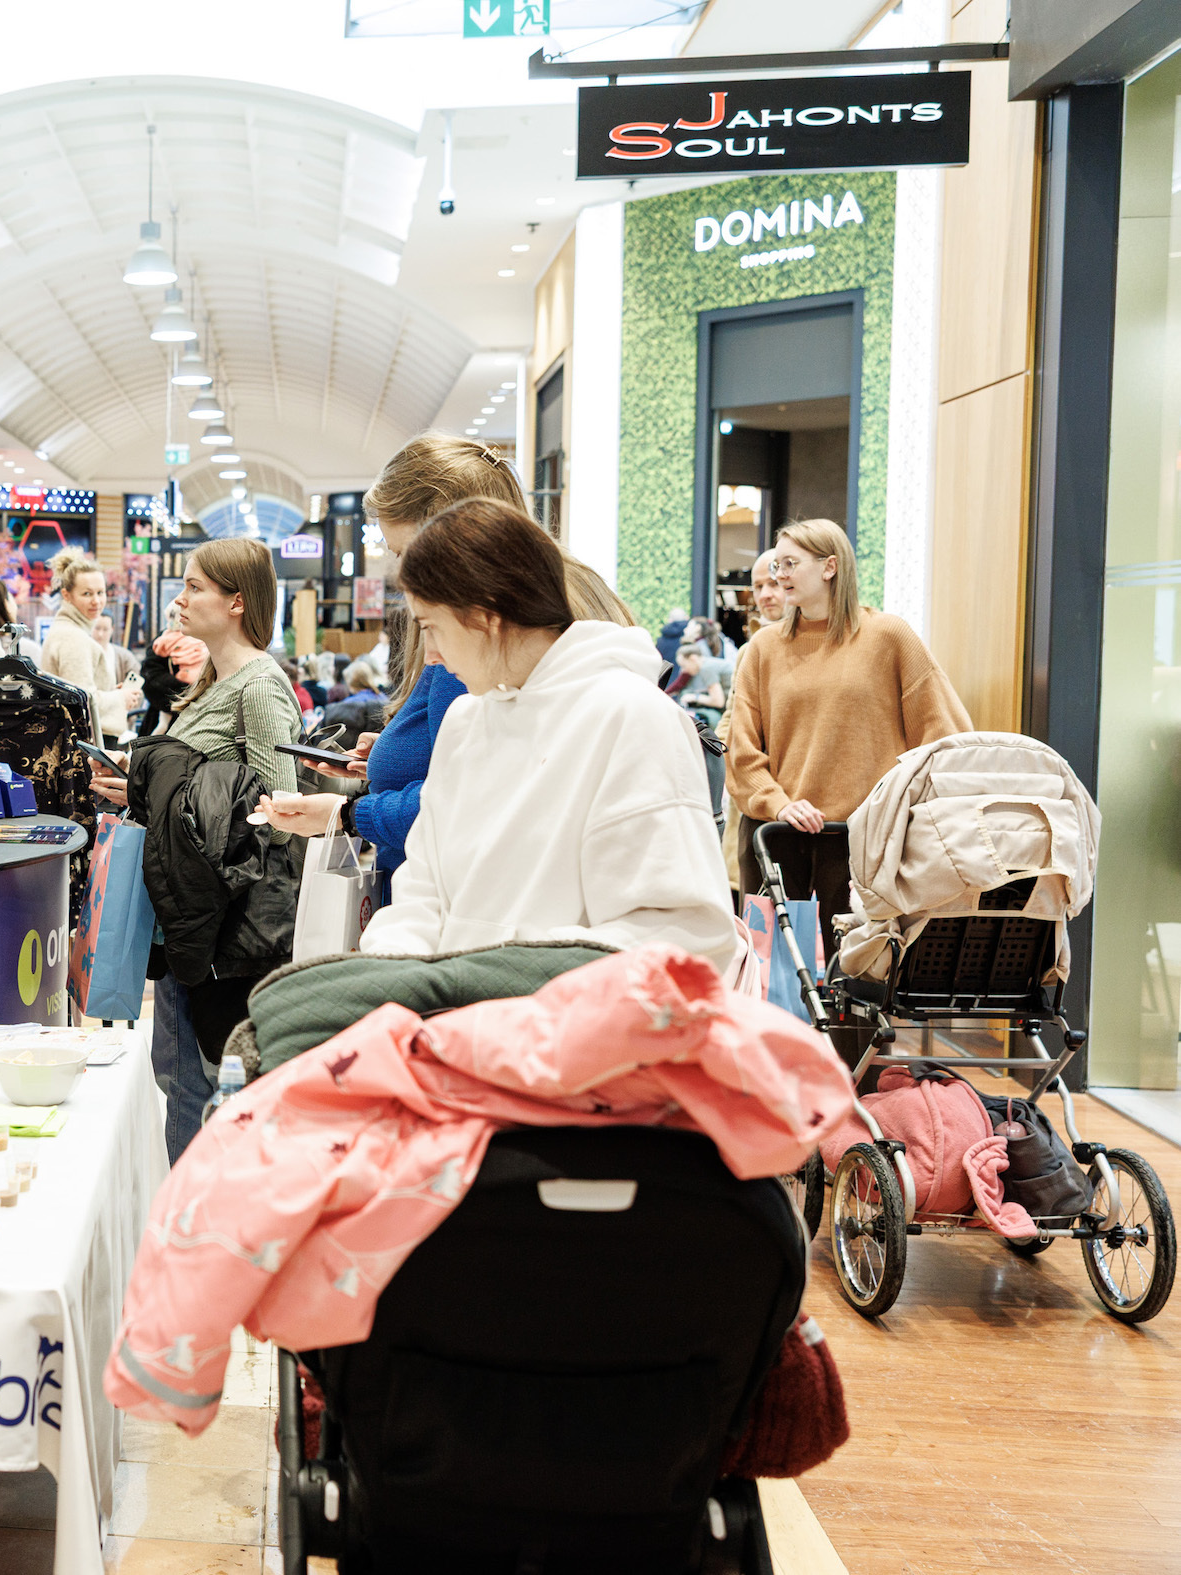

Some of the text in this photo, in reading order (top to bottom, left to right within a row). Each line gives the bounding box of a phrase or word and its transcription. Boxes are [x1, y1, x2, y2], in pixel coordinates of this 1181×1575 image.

[674, 91, 944, 131] JAHONTS
[605, 121, 785, 160] SOUL
[694, 190, 865, 252] DOMINA
[739, 244, 816, 269] SHOPPING
